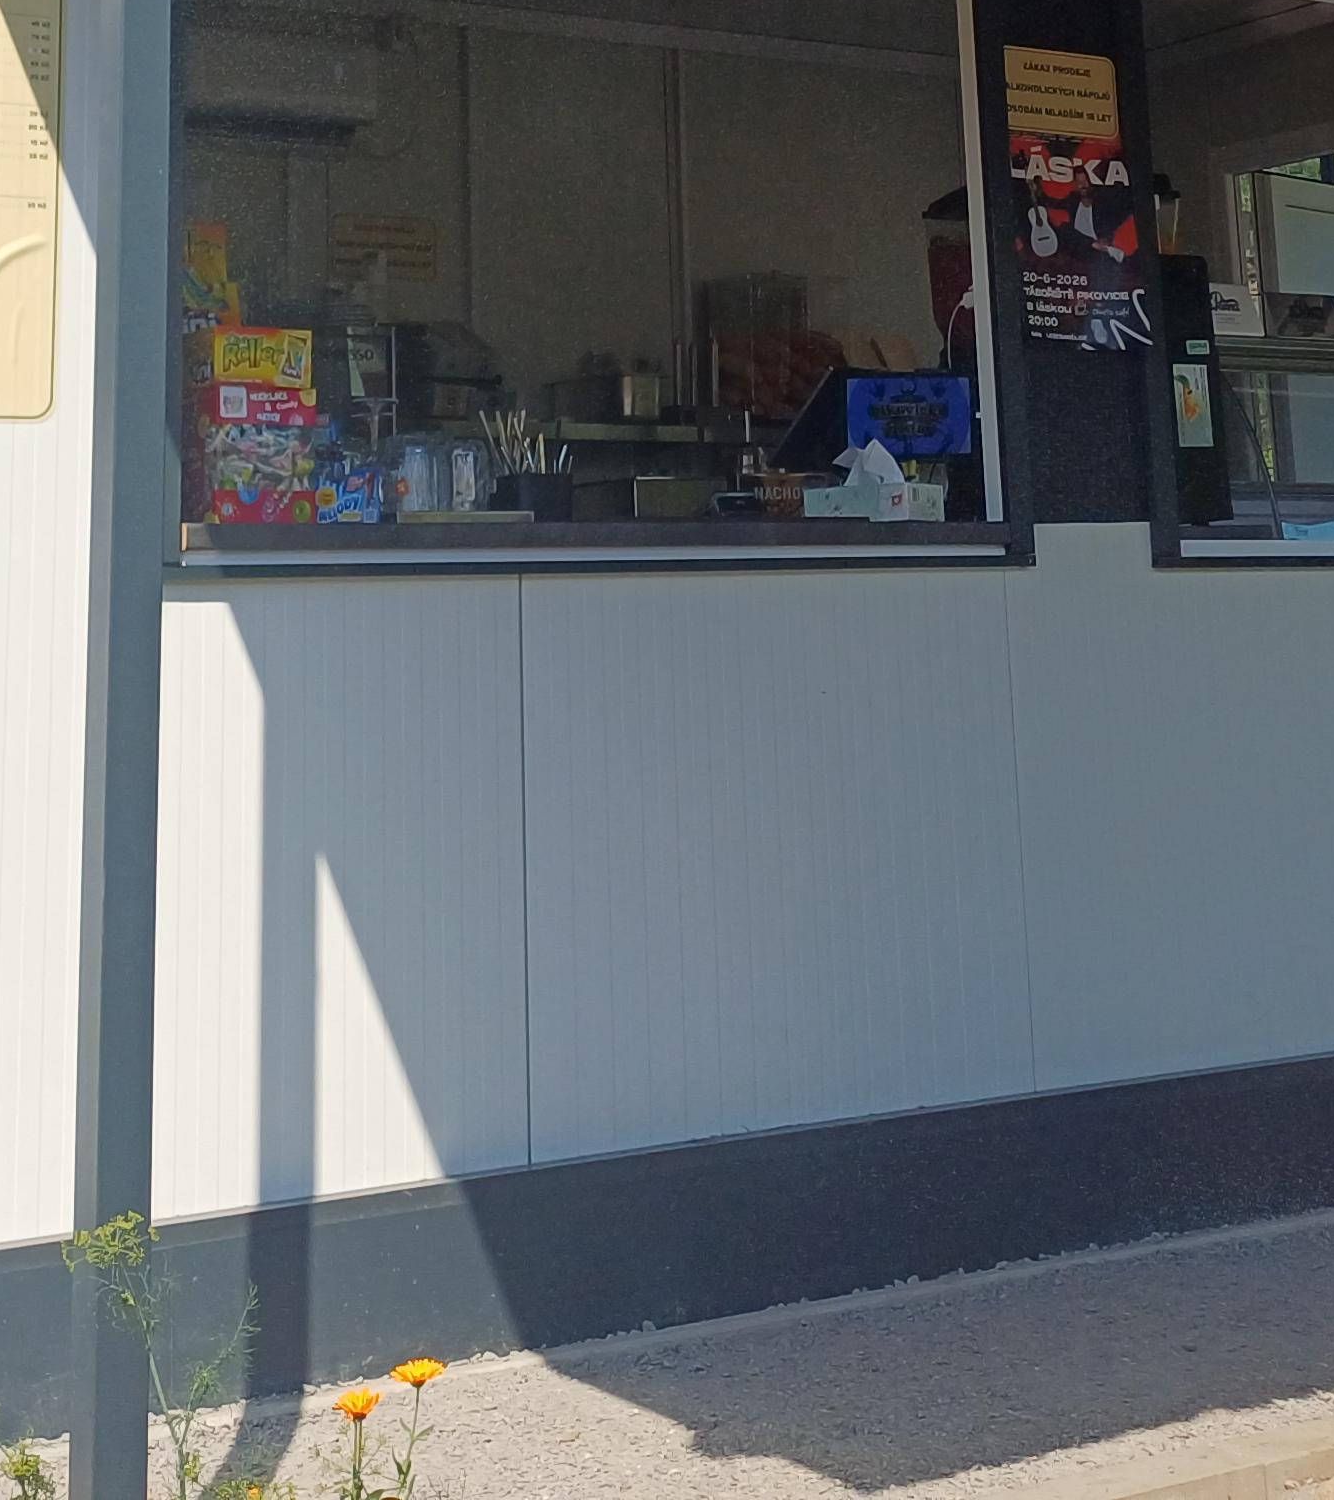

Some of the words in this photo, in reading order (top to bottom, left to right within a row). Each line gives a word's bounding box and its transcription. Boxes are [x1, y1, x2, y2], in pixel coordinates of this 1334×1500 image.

[1097, 113, 1112, 123] LET
[1022, 272, 1088, 286] 20-6-2026
[1028, 314, 1059, 327] 20:00
[754, 486, 805, 501] NACHO
